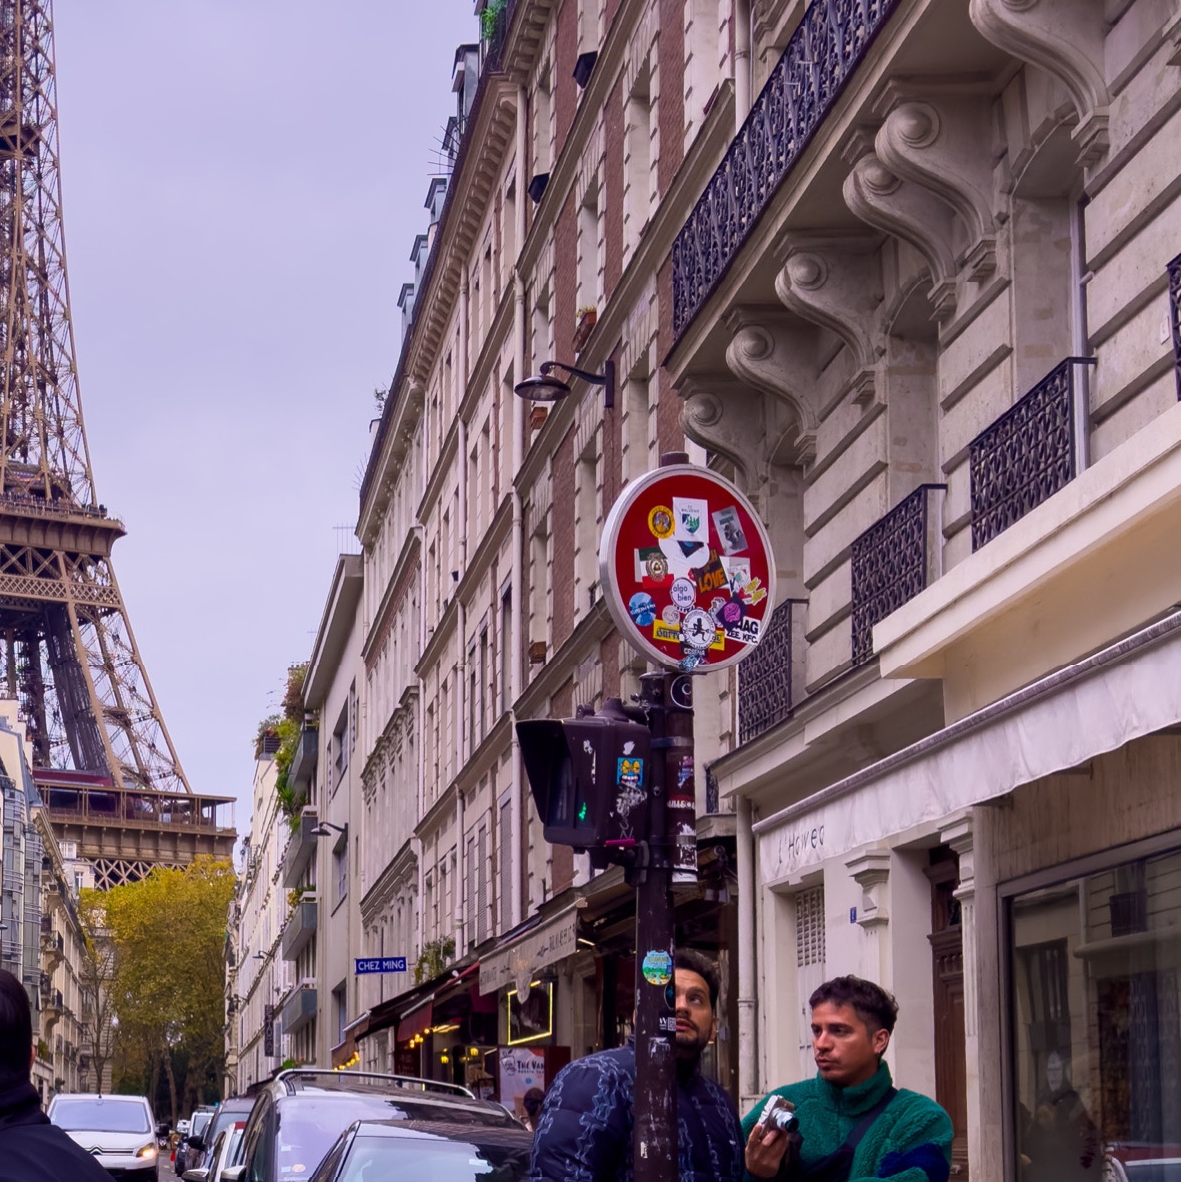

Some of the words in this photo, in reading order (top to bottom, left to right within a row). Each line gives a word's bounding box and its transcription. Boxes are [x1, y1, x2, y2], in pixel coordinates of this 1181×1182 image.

[699, 568, 726, 593] LOVE
[673, 584, 688, 596] algo
[677, 592, 692, 602] bien
[357, 961, 380, 971] CHEZ
[382, 959, 404, 970] MING
